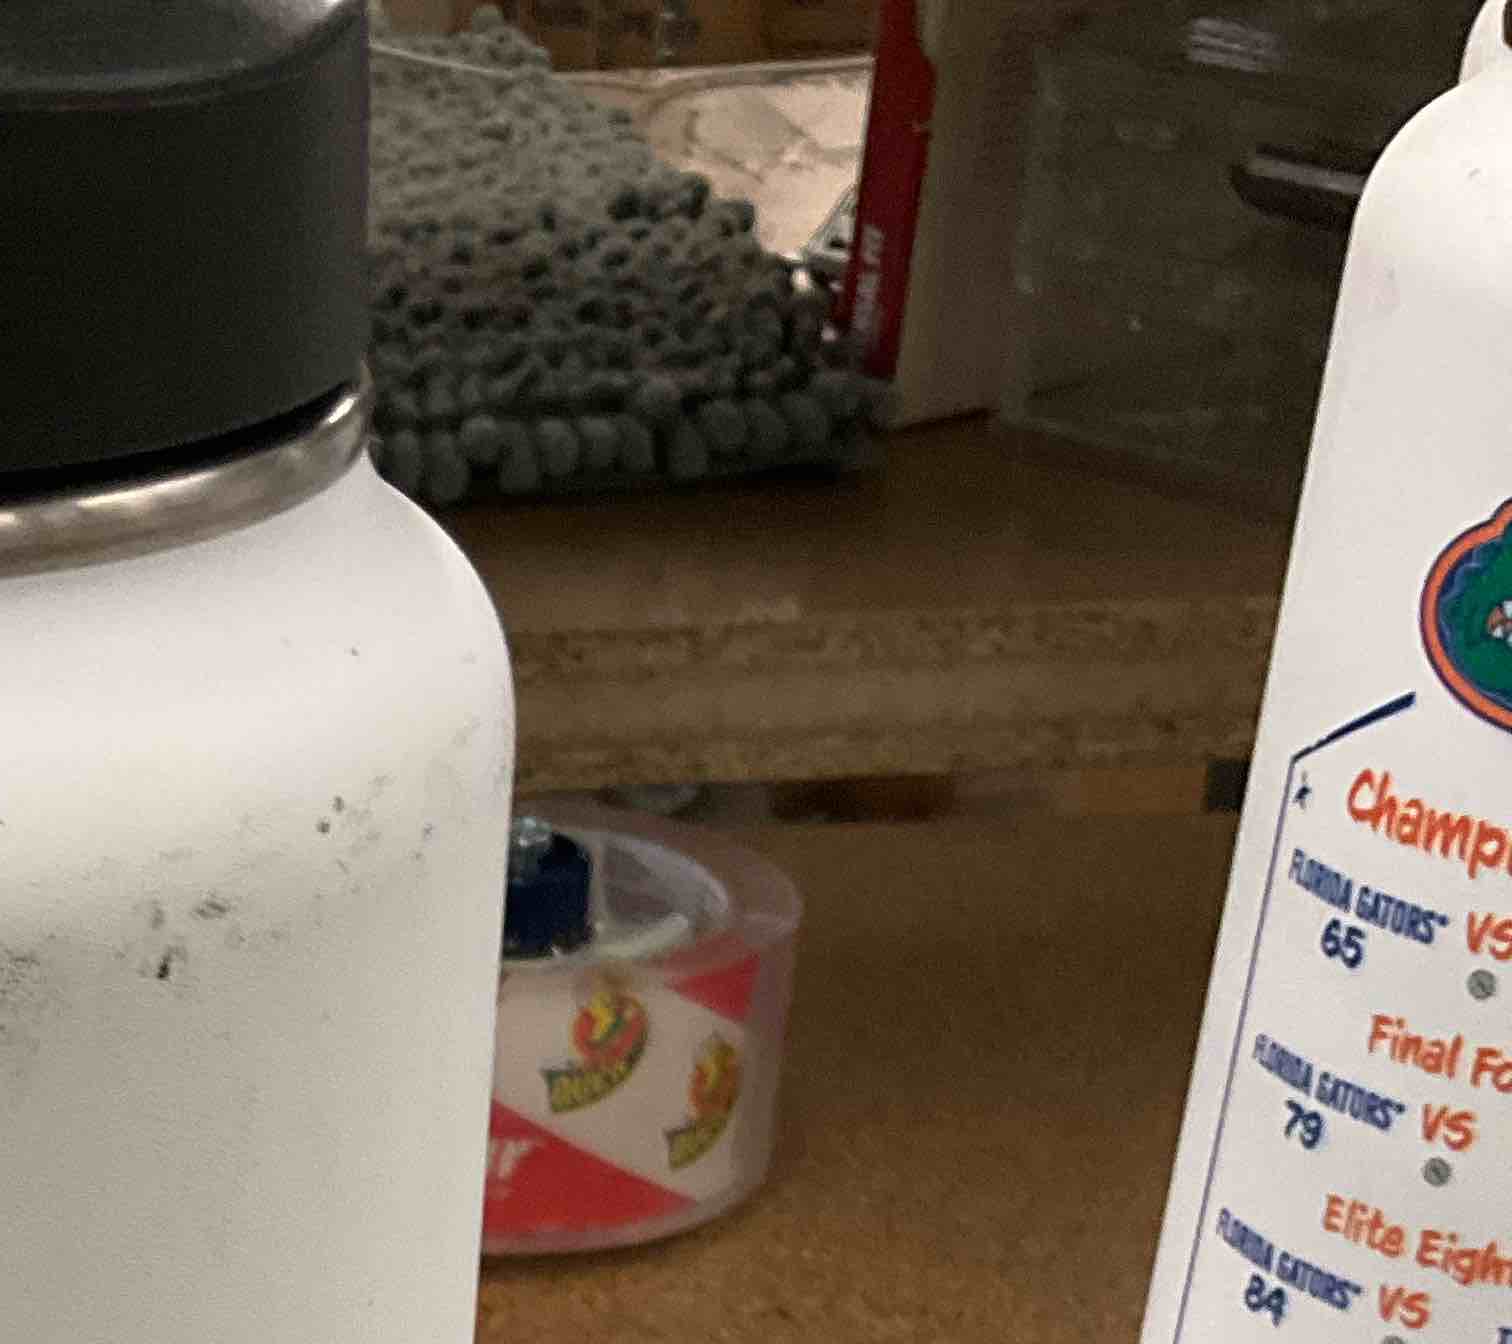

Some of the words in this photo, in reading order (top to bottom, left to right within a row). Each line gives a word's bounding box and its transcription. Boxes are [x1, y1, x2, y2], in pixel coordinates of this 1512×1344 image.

[1321, 919, 1365, 969] 65
[1368, 1014, 1464, 1079] Final
[1284, 1100, 1323, 1150] 79
[1323, 1193, 1405, 1257] Elite
[1245, 1274, 1286, 1327] 84
